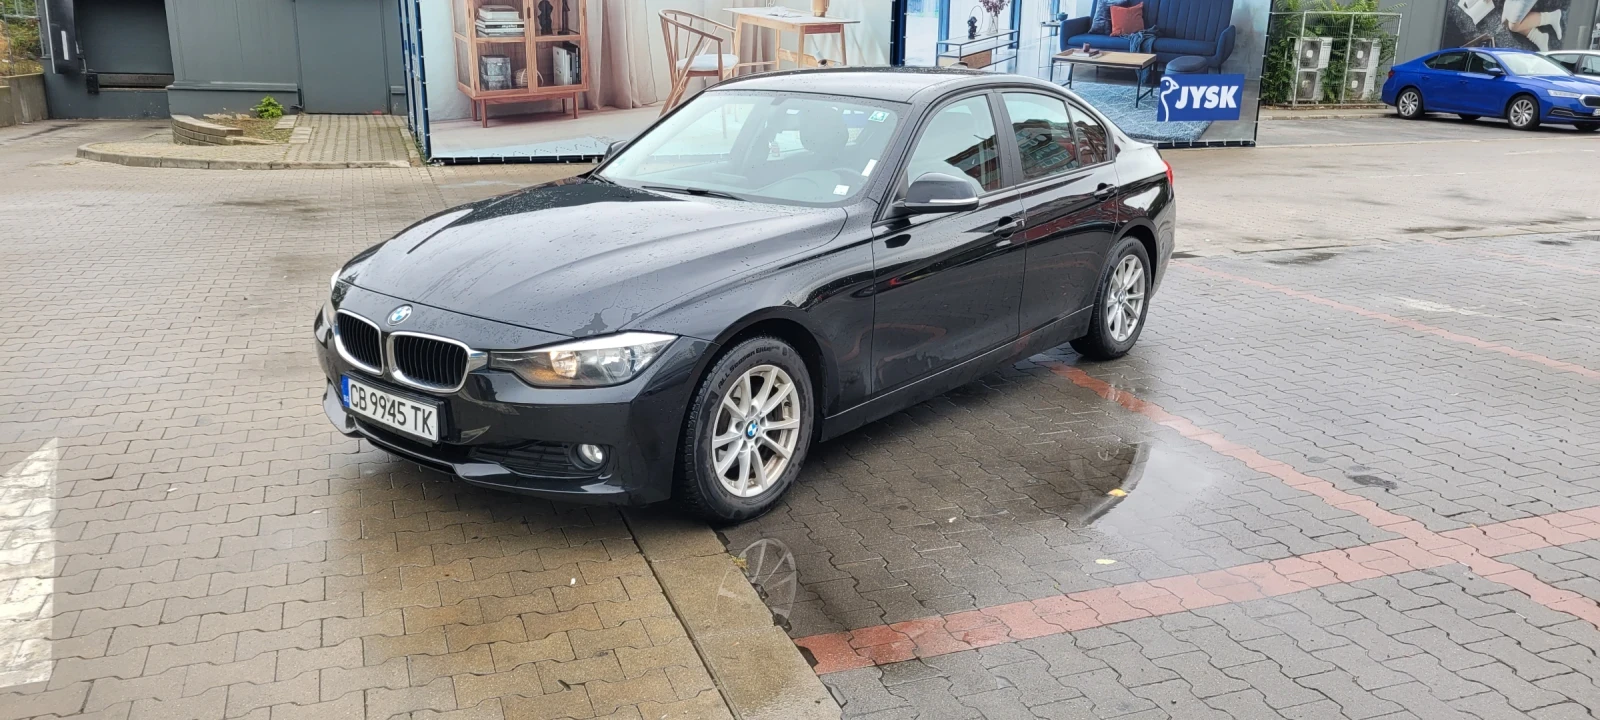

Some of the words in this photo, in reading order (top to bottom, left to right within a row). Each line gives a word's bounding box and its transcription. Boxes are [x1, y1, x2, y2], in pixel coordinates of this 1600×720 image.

[1175, 85, 1239, 109] JYSK
[350, 383, 367, 412] CB
[370, 391, 407, 426] 9945
[411, 405, 433, 436] TK
